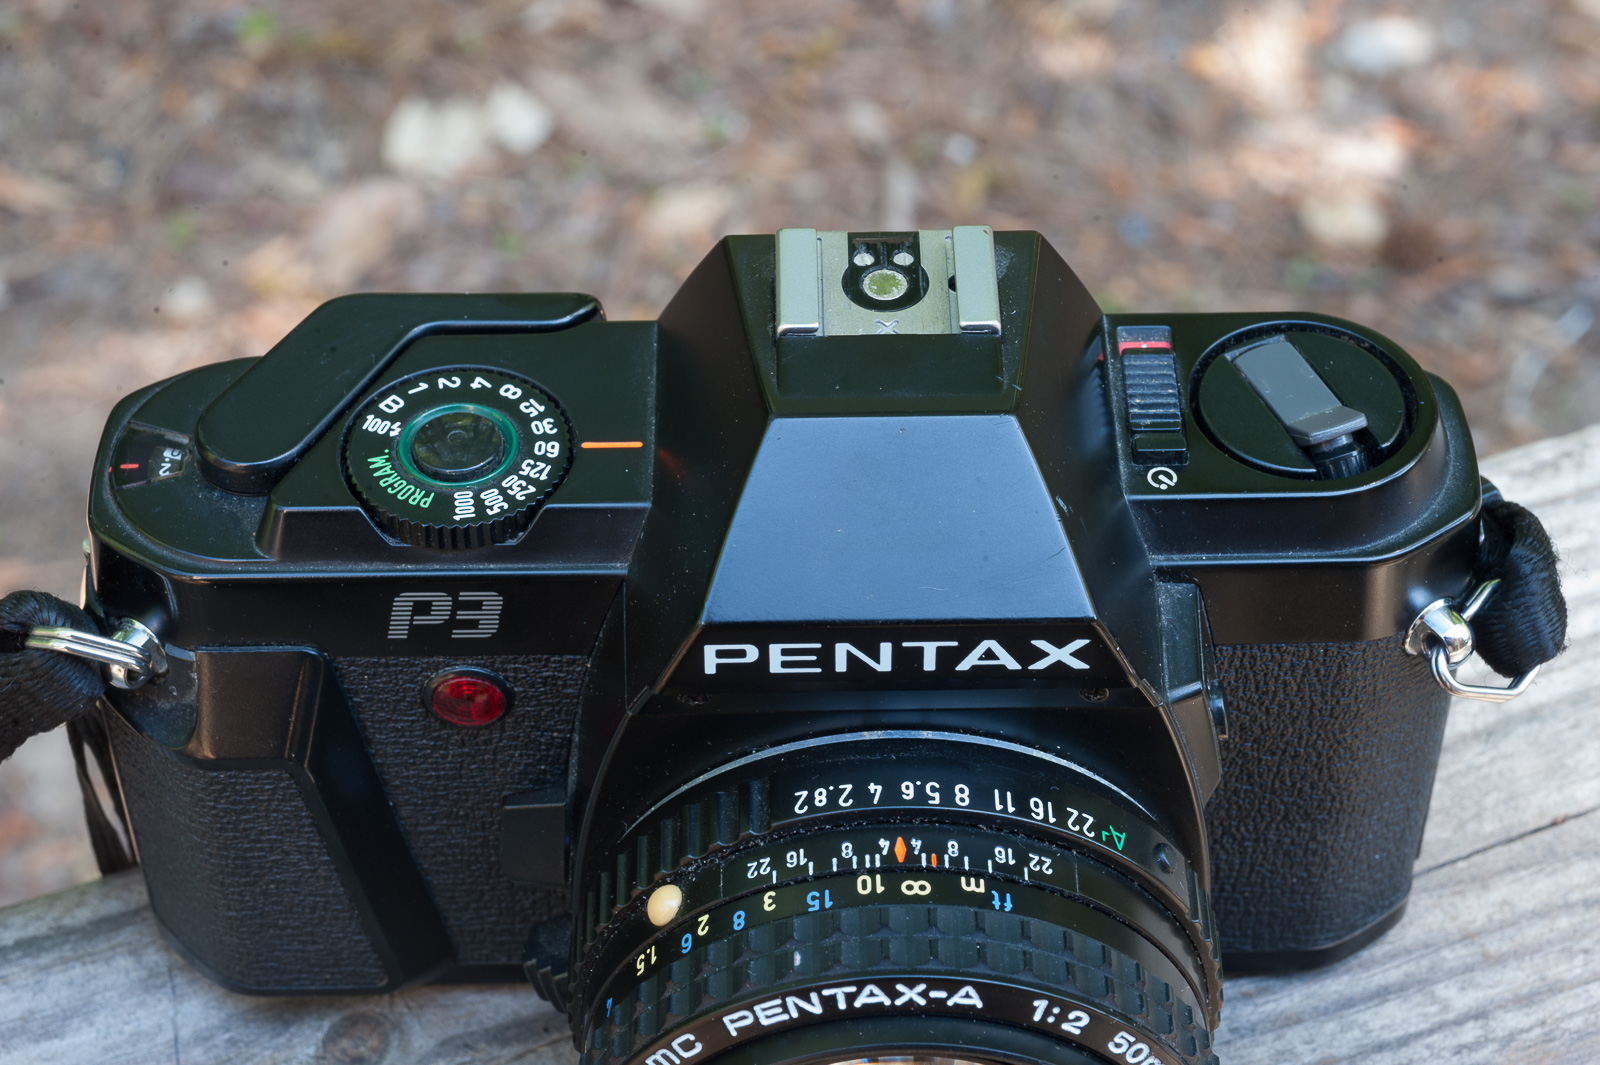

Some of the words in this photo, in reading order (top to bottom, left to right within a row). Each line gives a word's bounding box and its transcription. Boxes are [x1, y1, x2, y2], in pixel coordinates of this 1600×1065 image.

[407, 382, 429, 395] 1
[437, 376, 462, 390] 2
[469, 376, 493, 390] 4
[498, 383, 523, 400] 8
[378, 394, 405, 414] B
[519, 398, 546, 418] 15
[530, 417, 558, 436] 30
[533, 440, 560, 459] 60
[518, 458, 552, 482] 125
[501, 474, 537, 501] 250
[452, 490, 476, 522] 1000
[479, 488, 509, 516] 500
[387, 591, 504, 639] P3
[703, 639, 1092, 675] PENTAX
[867, 782, 883, 805] 4
[900, 780, 941, 805] 5.6
[954, 783, 970, 807] 8
[993, 788, 1016, 814] 11
[1029, 796, 1057, 824] 16
[1066, 807, 1096, 838] 22
[840, 841, 854, 859] 8
[877, 837, 891, 856] 4
[910, 837, 923, 856] 4
[946, 839, 959, 857] 8
[993, 845, 1017, 866] 16
[746, 856, 771, 879] 22
[785, 848, 808, 869] 16
[1028, 852, 1054, 875] 22
[856, 873, 886, 895] 10
[960, 876, 986, 894] m
[763, 890, 777, 912] 3
[806, 889, 834, 912] 15
[990, 889, 1014, 913] ft
[697, 913, 710, 936] 2
[732, 910, 746, 931] 8
[681, 932, 693, 954] 6
[636, 945, 658, 976] 1.5
[722, 983, 984, 1037] PENTAX-A
[1032, 999, 1090, 1035] 1:2
